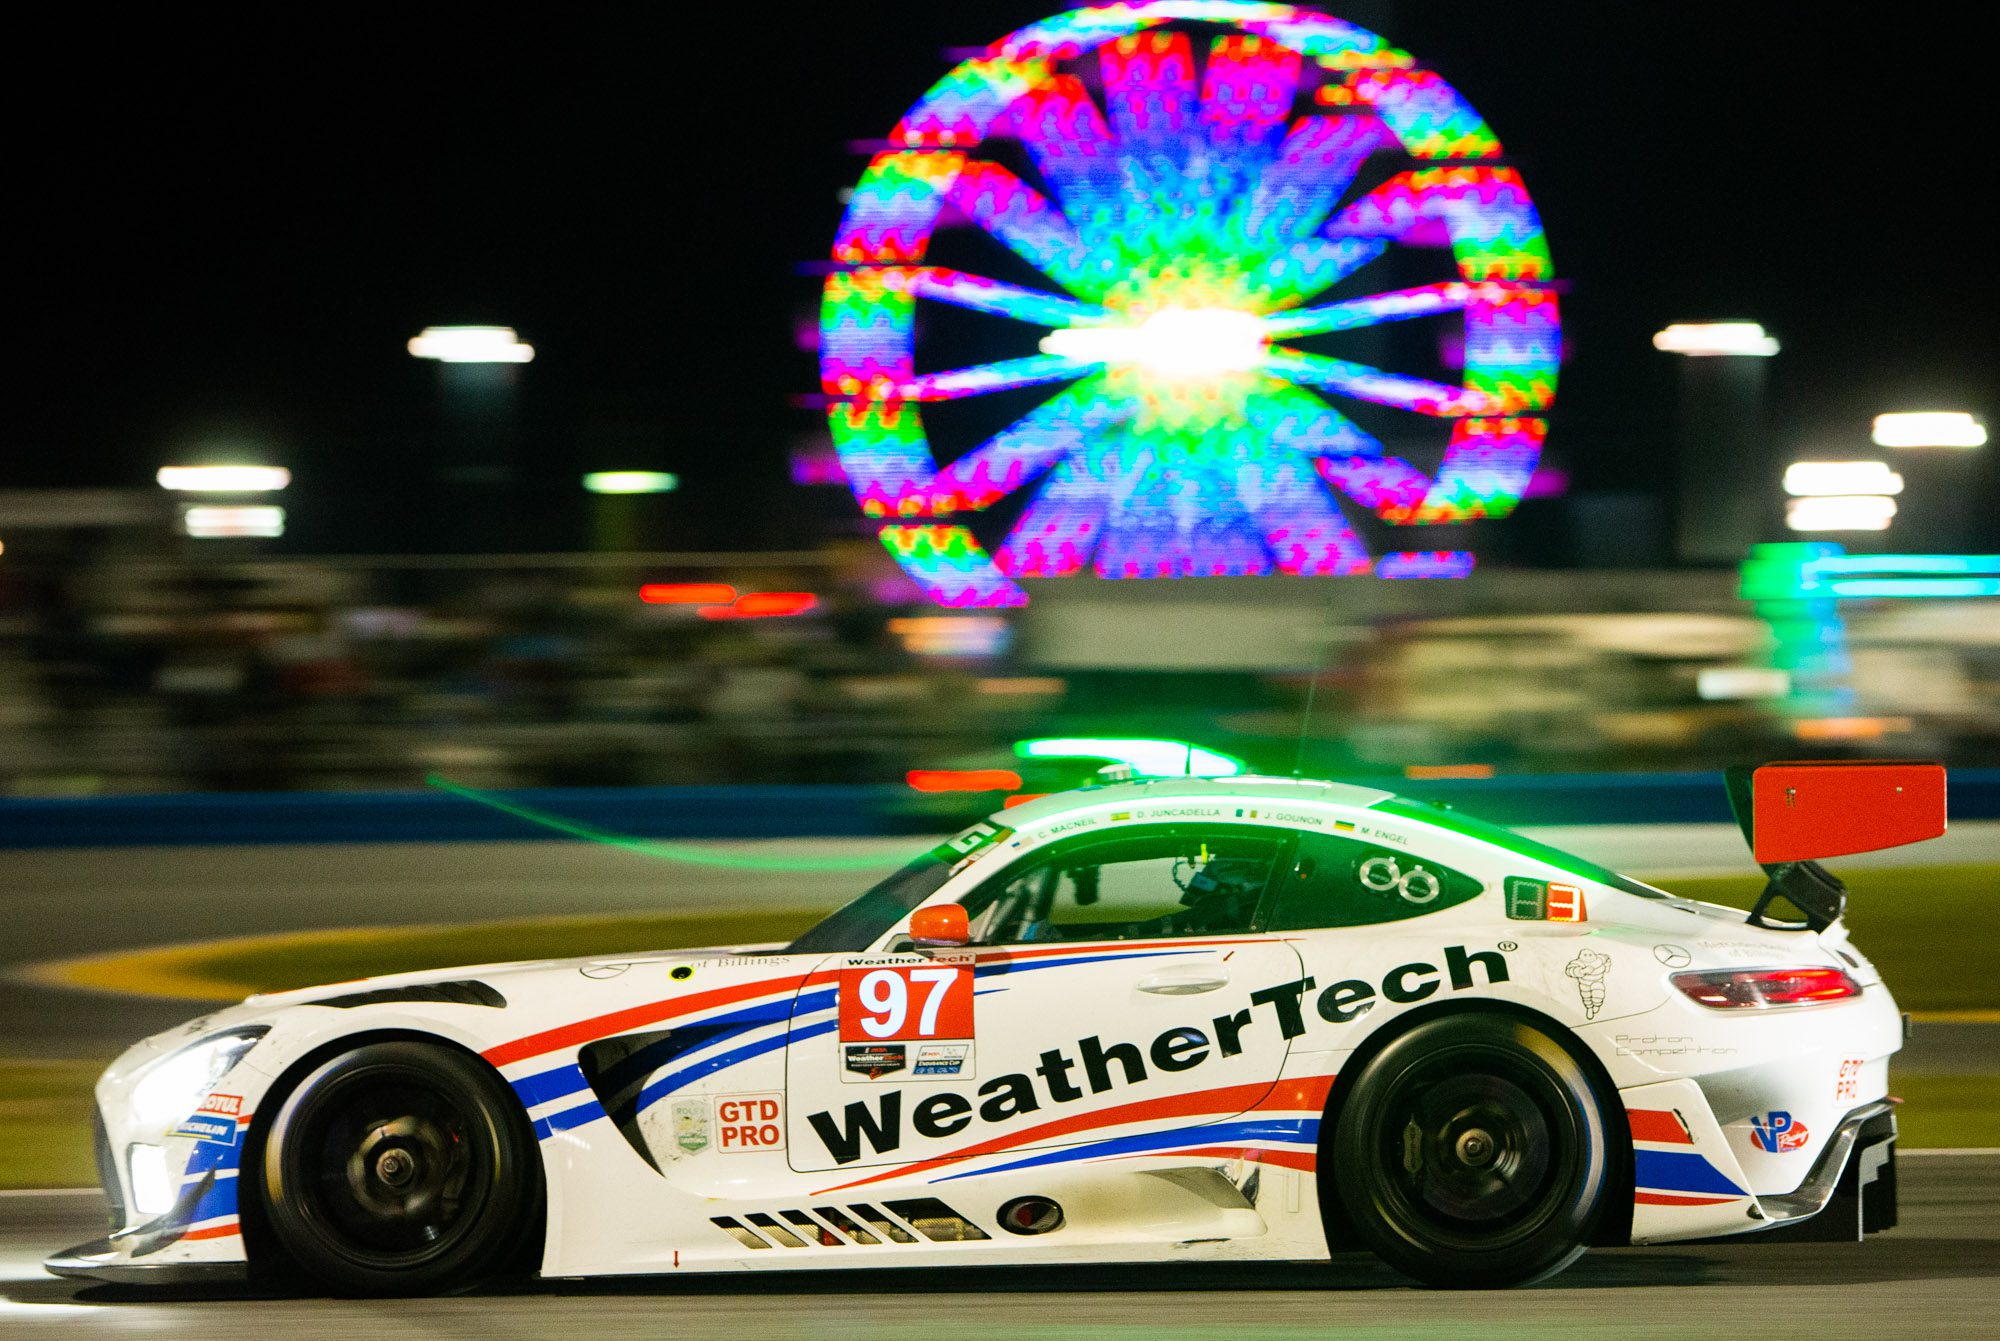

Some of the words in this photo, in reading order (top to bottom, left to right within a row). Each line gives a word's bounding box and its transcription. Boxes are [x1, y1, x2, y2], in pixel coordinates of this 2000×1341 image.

[1150, 808, 1221, 818] JUNCADELLA
[1275, 811, 1323, 826] GOUNON
[1050, 818, 1098, 835] MACNEIL
[1374, 829, 1409, 846] ENGEL
[718, 955, 791, 968] Billings
[858, 968, 959, 1038] 97
[1615, 1034, 1694, 1044] Proton
[201, 1096, 240, 1113] OTUL
[719, 1099, 779, 1123] GTD
[721, 1123, 780, 1148] PRO
[1750, 1110, 1793, 1153] VP
